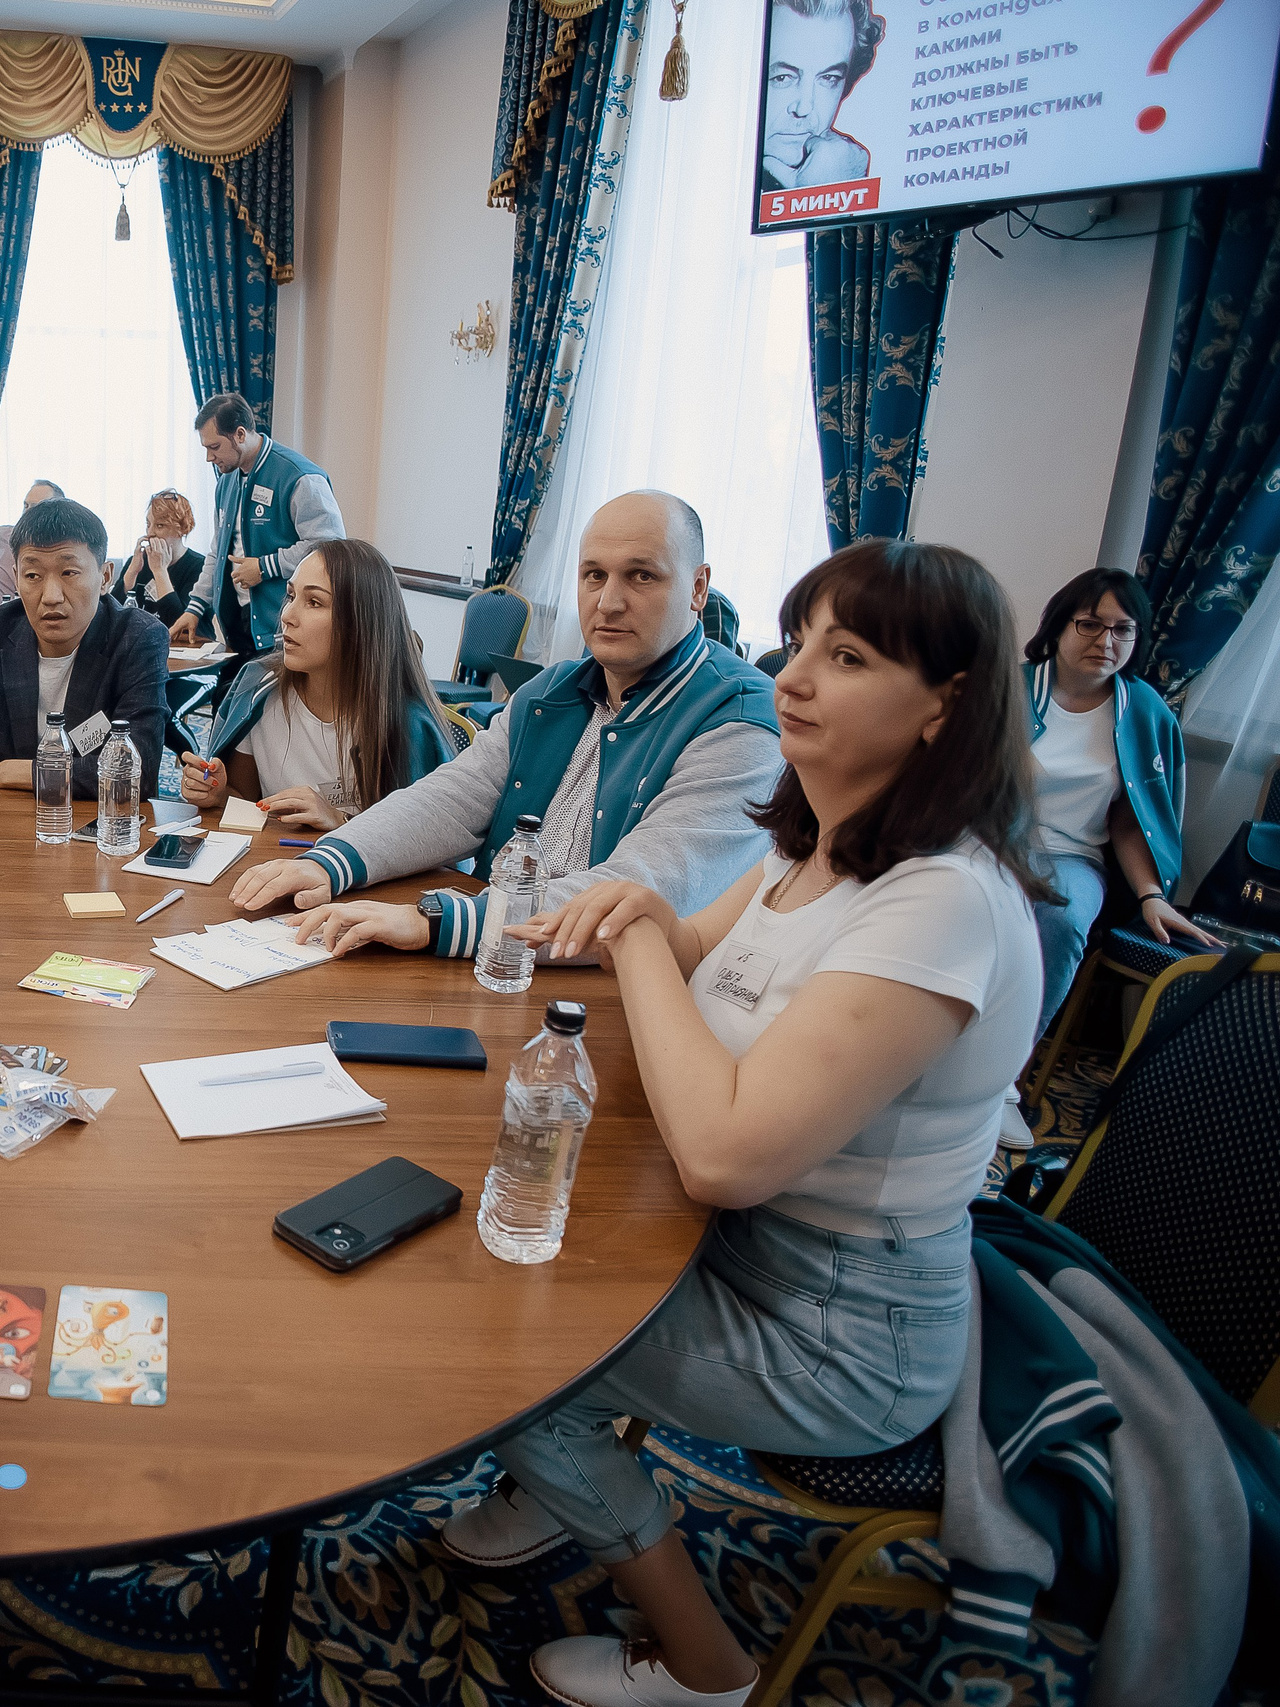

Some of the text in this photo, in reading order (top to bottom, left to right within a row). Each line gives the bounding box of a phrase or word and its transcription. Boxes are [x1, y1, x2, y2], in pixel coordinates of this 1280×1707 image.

[917, 0, 1063, 34] в команда
[914, 28, 1002, 60] КАКИМИ
[911, 41, 1079, 89] ДОЛЖНЫ БЫТЬ
[909, 76, 1028, 112] КЛЮЧЕВЫЕ
[907, 91, 1103, 138] ХАРАКТЕРИСТИКИ
[905, 127, 1029, 163] ПРОЕКТНОЙ
[903, 160, 1011, 189] КОМАНДЫ
[770, 196, 785, 216] 5
